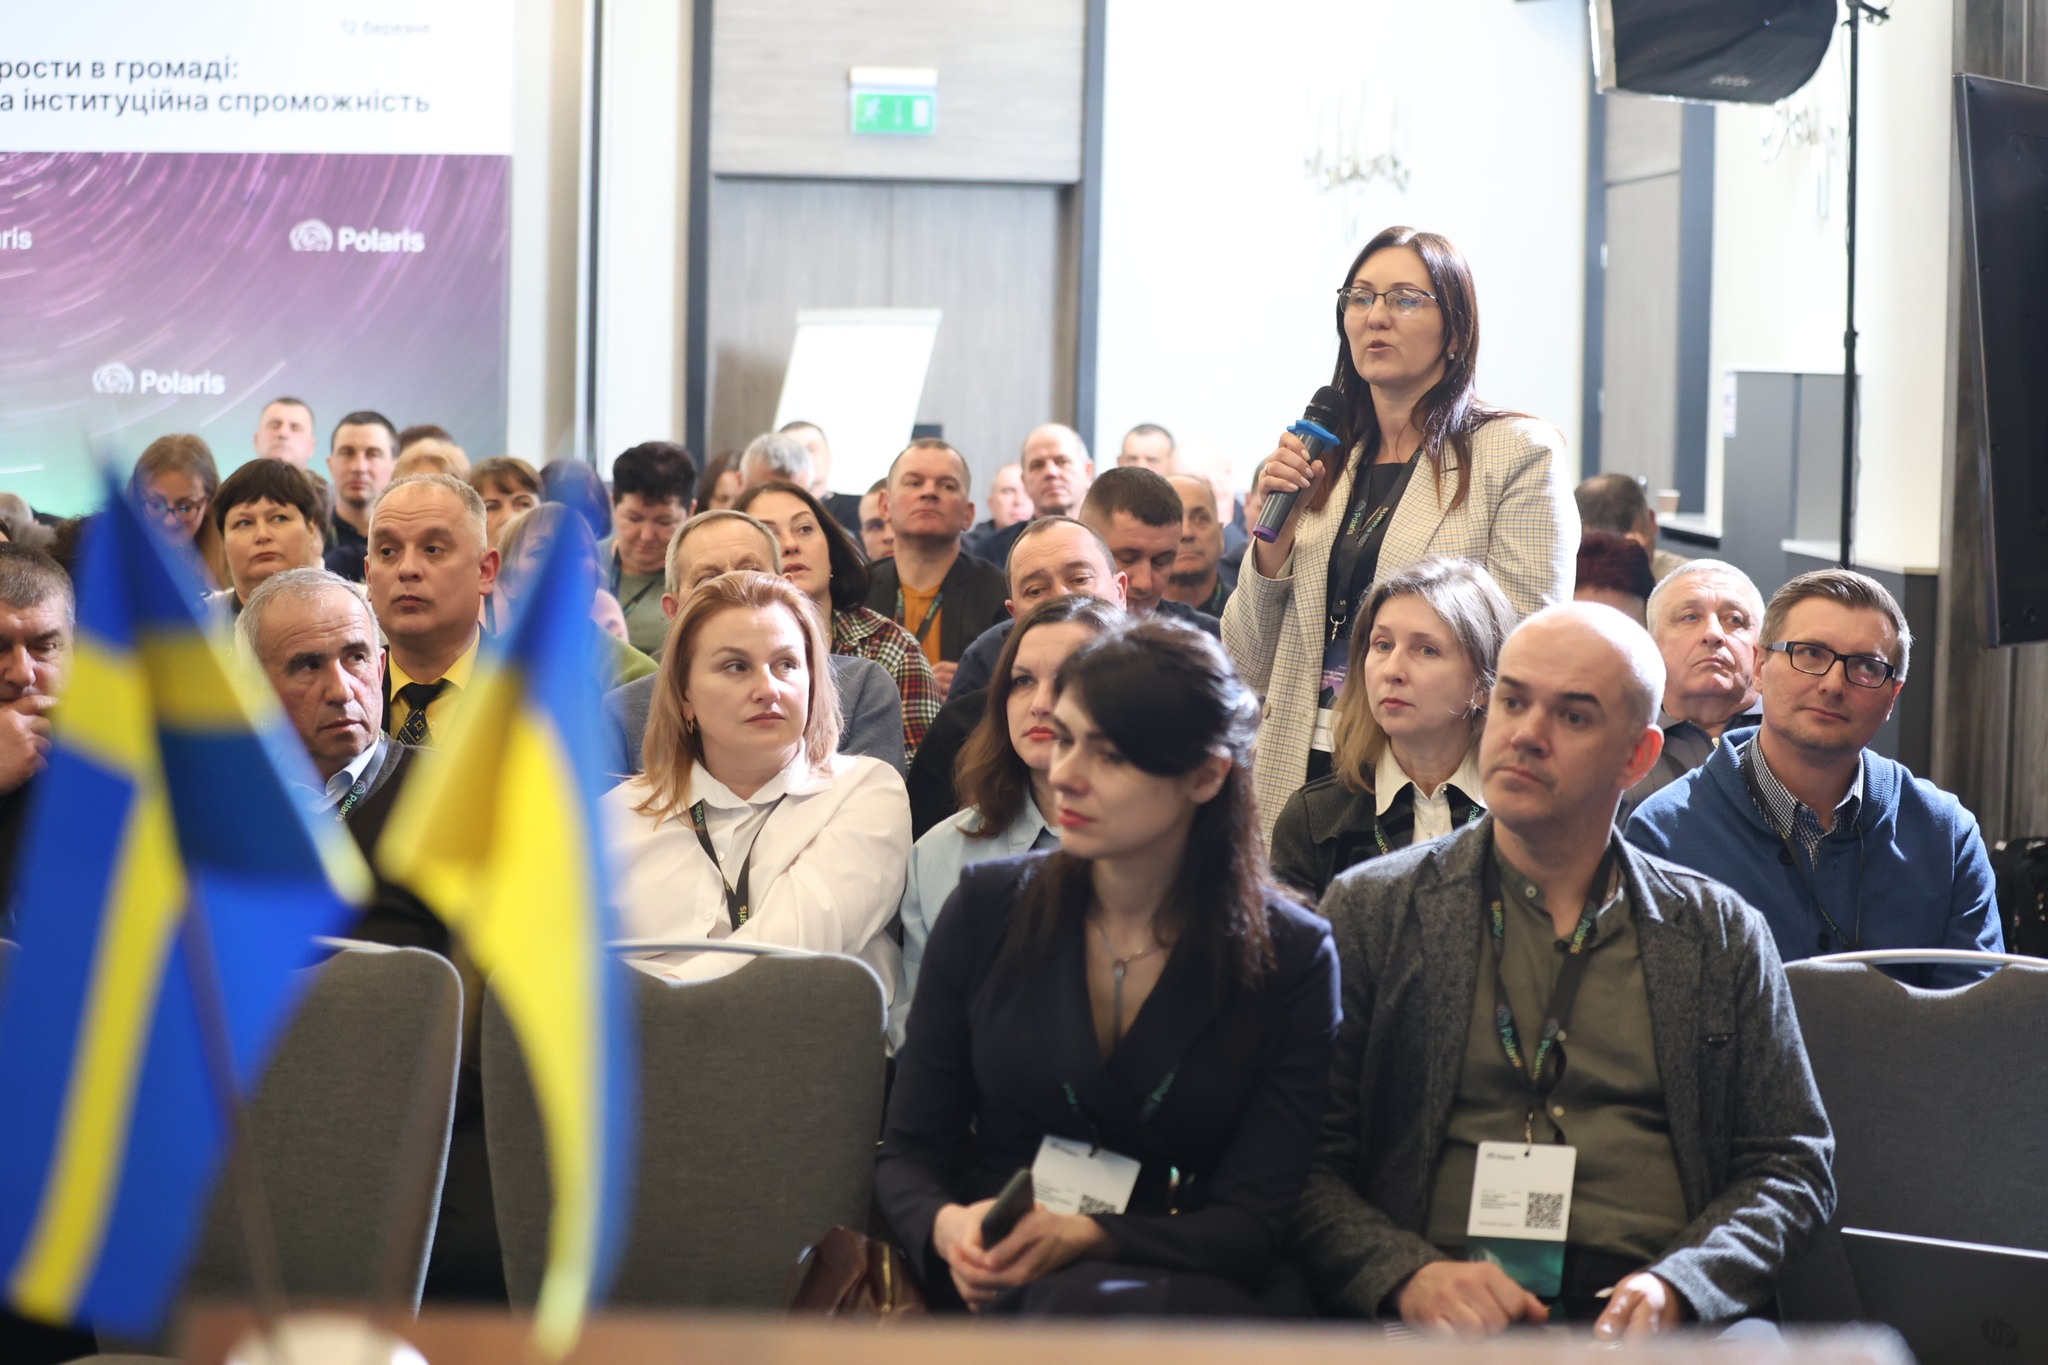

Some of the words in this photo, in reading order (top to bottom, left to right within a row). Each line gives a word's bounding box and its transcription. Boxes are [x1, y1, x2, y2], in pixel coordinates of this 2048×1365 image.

[92, 61, 105, 78] в
[116, 56, 240, 85] громаді:
[23, 88, 208, 116] інституційна
[218, 88, 430, 116] спроможність
[339, 227, 426, 253] Polaris
[140, 370, 226, 396] Polaris
[1346, 512, 1361, 536] Polaris
[336, 794, 358, 822] Polaris
[1569, 919, 1592, 955] Polaris
[1500, 1026, 1523, 1068] Polaris
